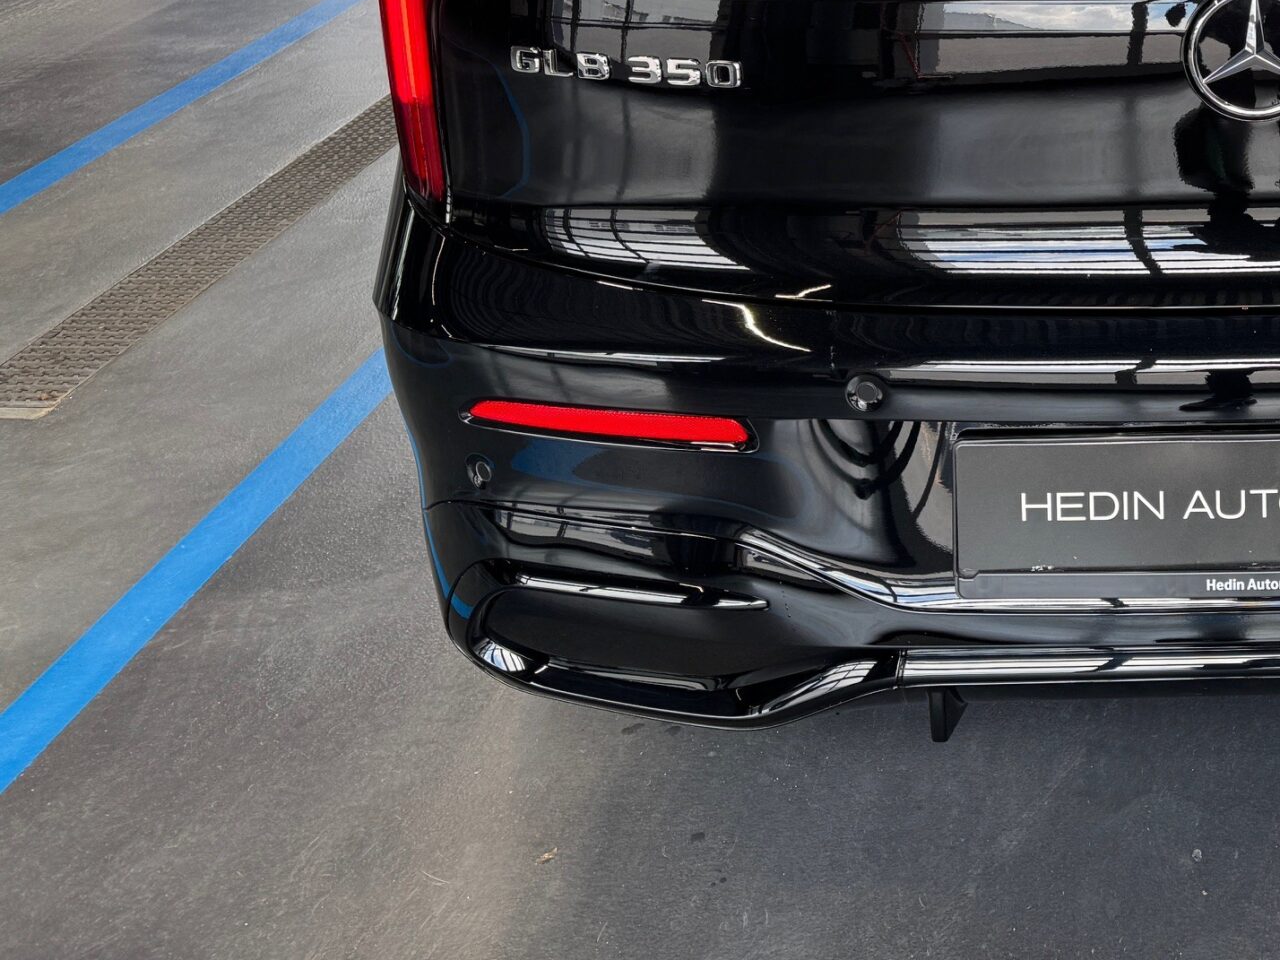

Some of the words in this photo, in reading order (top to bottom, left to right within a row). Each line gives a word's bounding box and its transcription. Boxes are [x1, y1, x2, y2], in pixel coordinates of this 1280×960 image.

[510, 45, 611, 81] GLB
[627, 54, 743, 89] 350
[1020, 490, 1166, 522] HEDIN
[1206, 578, 1245, 591] Hedin
